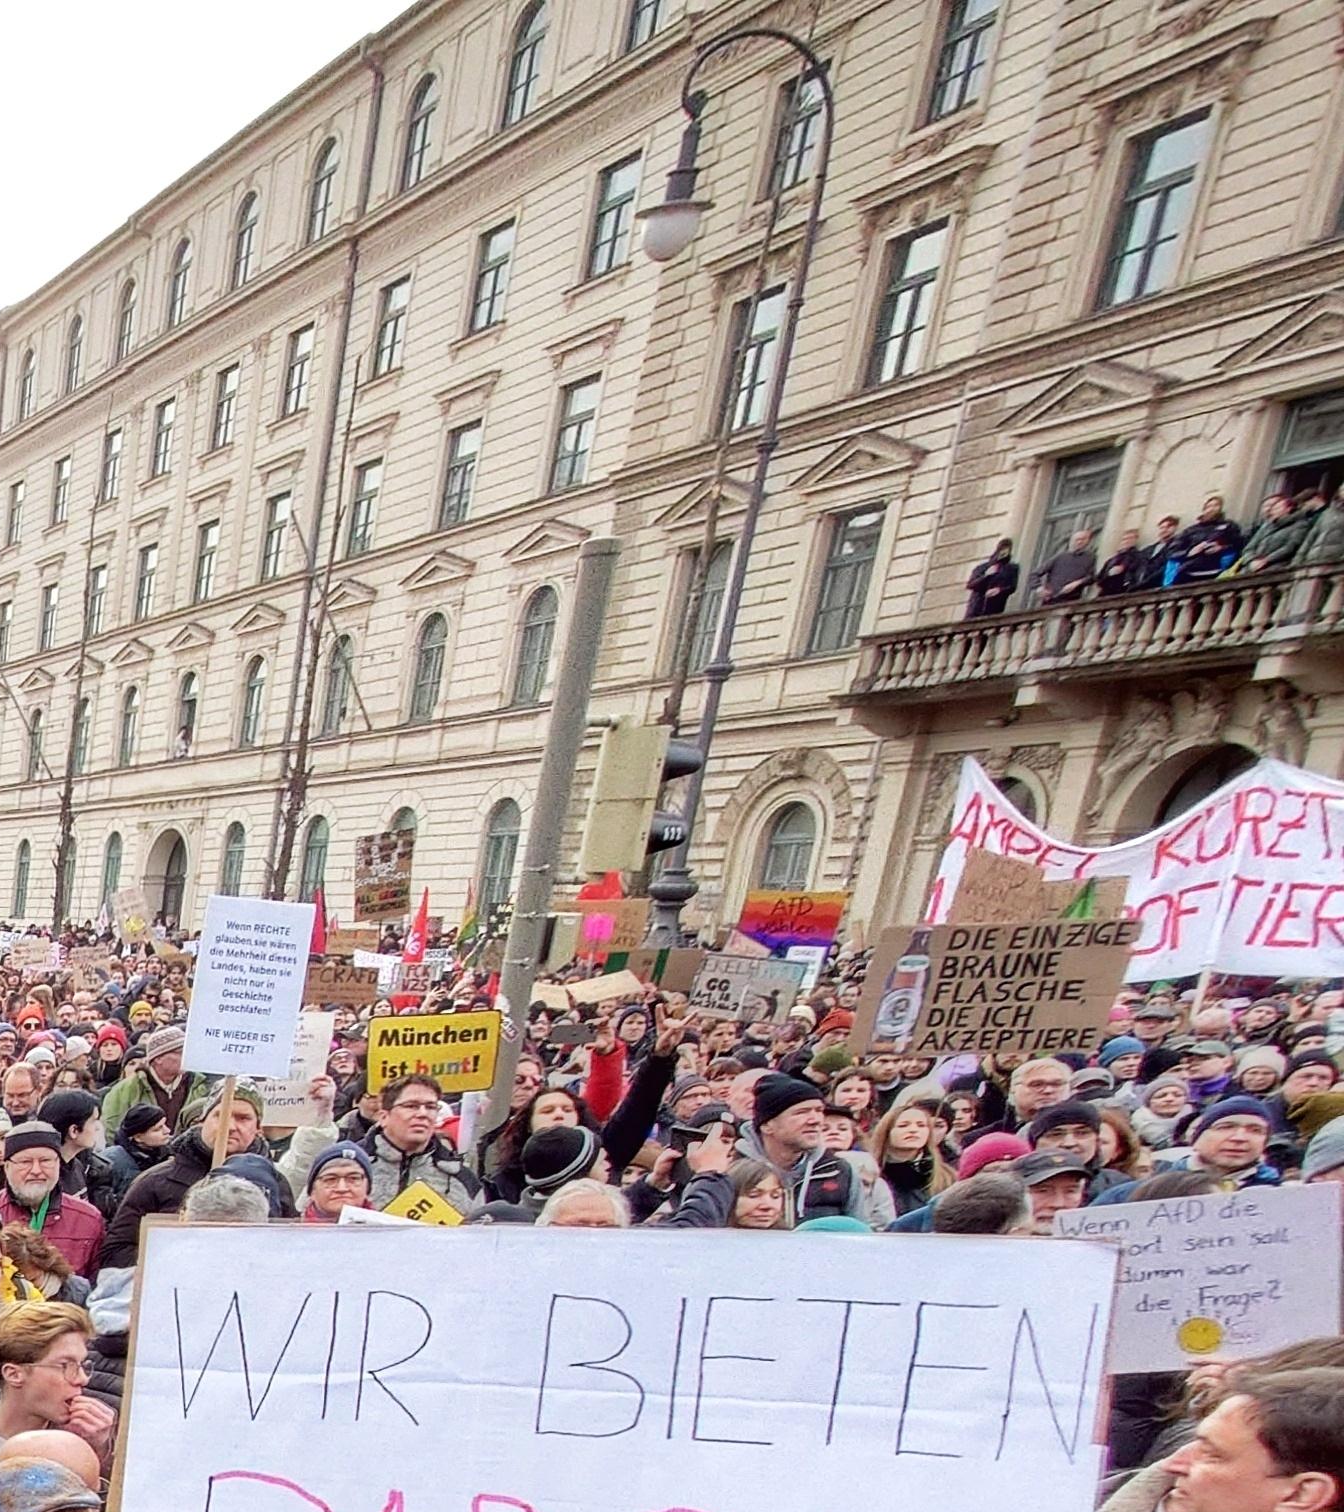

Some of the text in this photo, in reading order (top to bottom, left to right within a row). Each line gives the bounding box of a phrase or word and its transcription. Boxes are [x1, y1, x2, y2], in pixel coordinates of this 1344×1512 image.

[226, 921, 291, 936] Wenn RECHTE
[949, 921, 1138, 949] DIE EINZIGE
[269, 941, 297, 951] wären
[210, 947, 297, 965] die Mehrheit dieses
[249, 966, 277, 976] haben
[279, 969, 292, 978] sie
[938, 952, 1062, 979] BRAUNE
[224, 976, 275, 989] nicht nur in
[222, 989, 273, 1002] Geschichte
[932, 979, 1087, 1005] FLASCHE,
[218, 1003, 272, 1016] geschlafen!
[926, 1005, 1035, 1028] DIE ICH
[205, 1028, 275, 1043] NIE WIEDER IST
[378, 1026, 488, 1047] München
[916, 1028, 1097, 1051] AKZEPTIERE
[222, 1043, 255, 1054] JETZT!
[381, 1055, 479, 1078] ist bunt!
[1059, 1201, 1262, 1236] Wenn AfD die
[1184, 1235, 1234, 1252] sein
[1207, 1264, 1252, 1275] war
[1135, 1279, 1283, 1316] die Frage?
[173, 1286, 1100, 1463] WIR BIETEN
